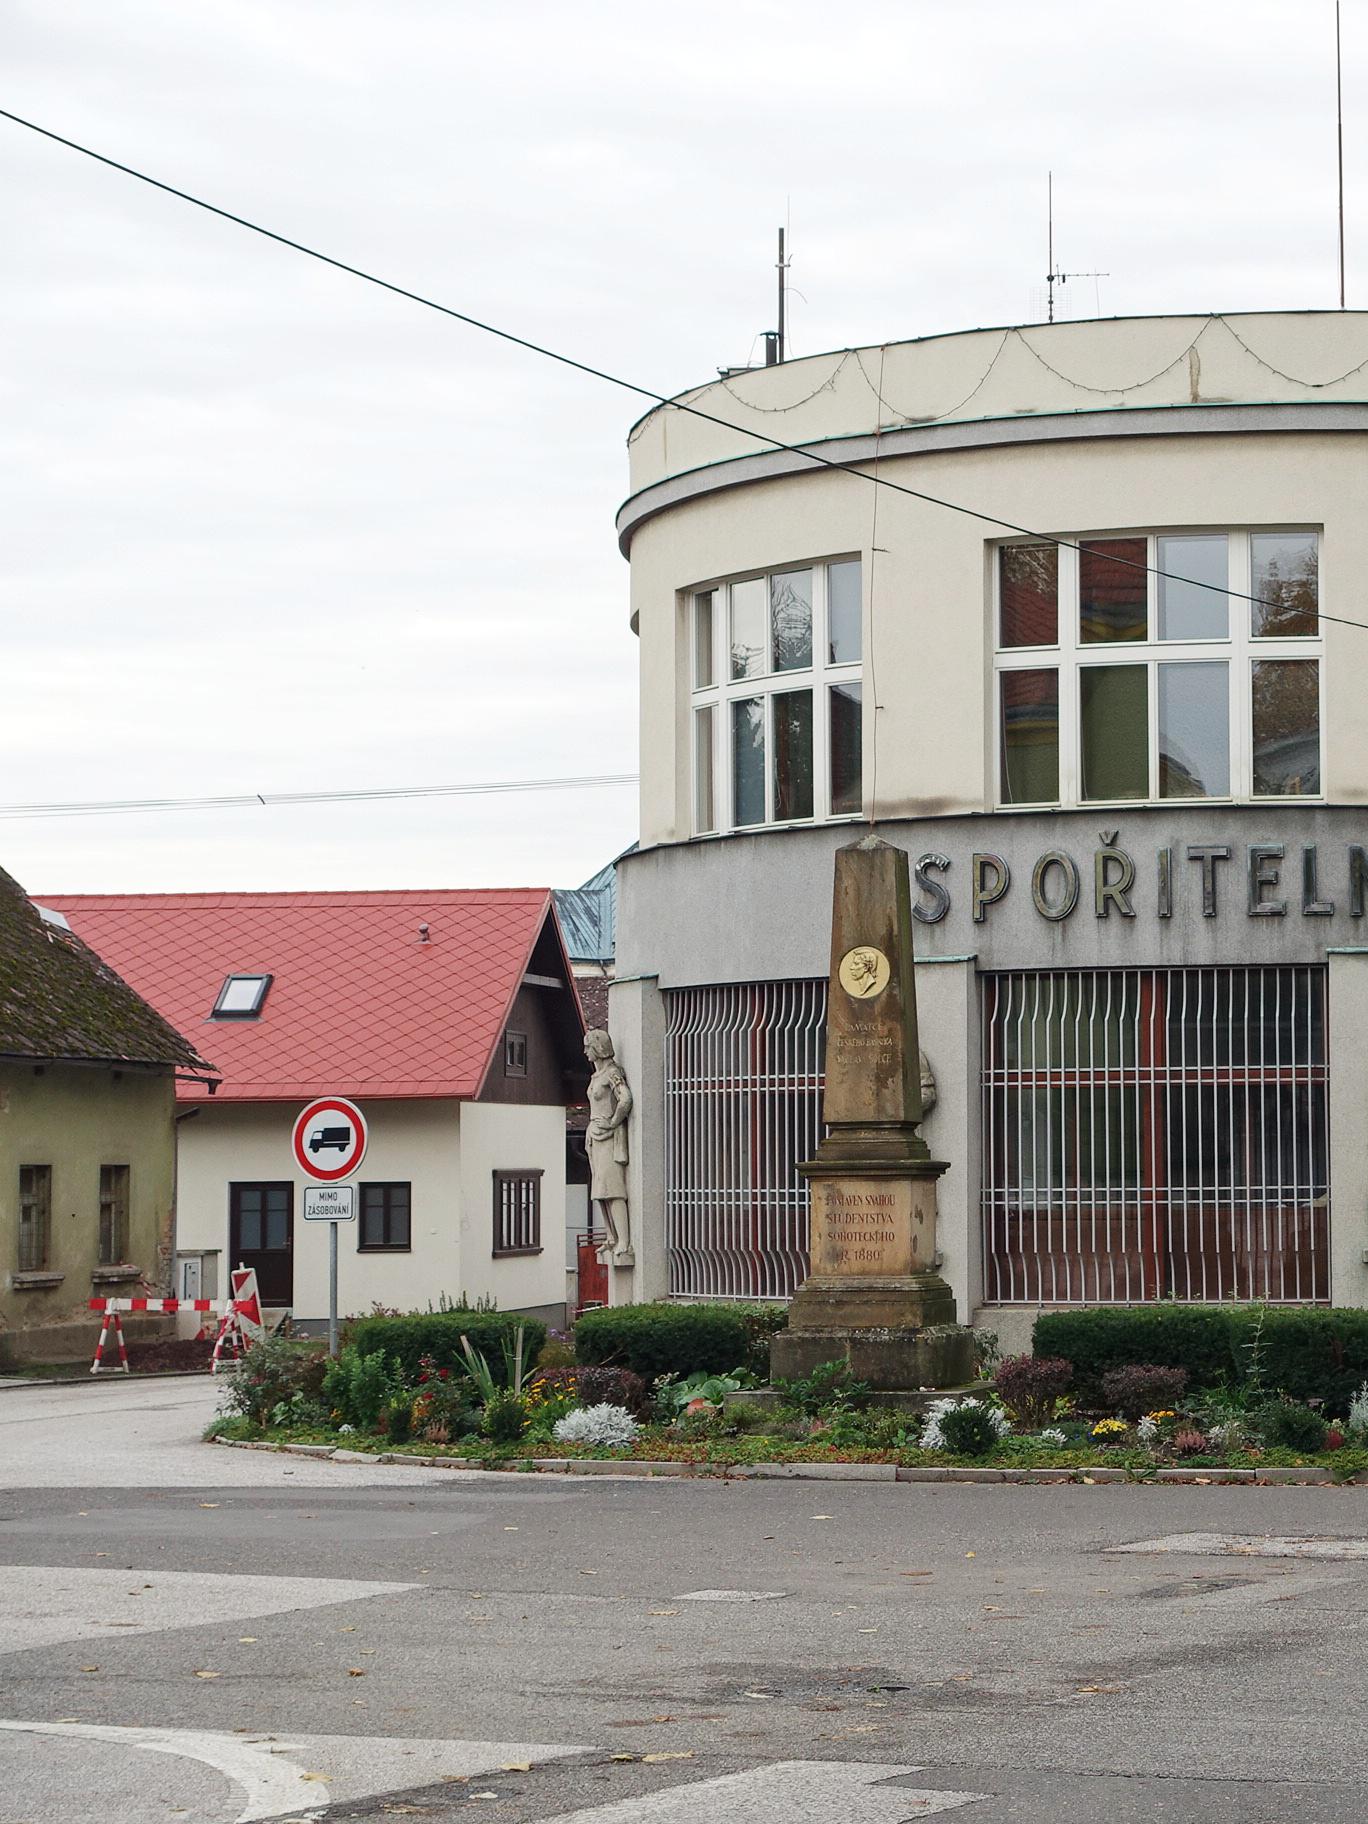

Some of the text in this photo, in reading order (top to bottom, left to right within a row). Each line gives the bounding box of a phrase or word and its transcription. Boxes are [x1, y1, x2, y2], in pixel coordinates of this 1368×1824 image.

[319, 1191, 338, 1201] MIMO
[308, 1202, 349, 1215] ZÁSOBOVÁNÍ
[854, 1249, 880, 1262] 1880
